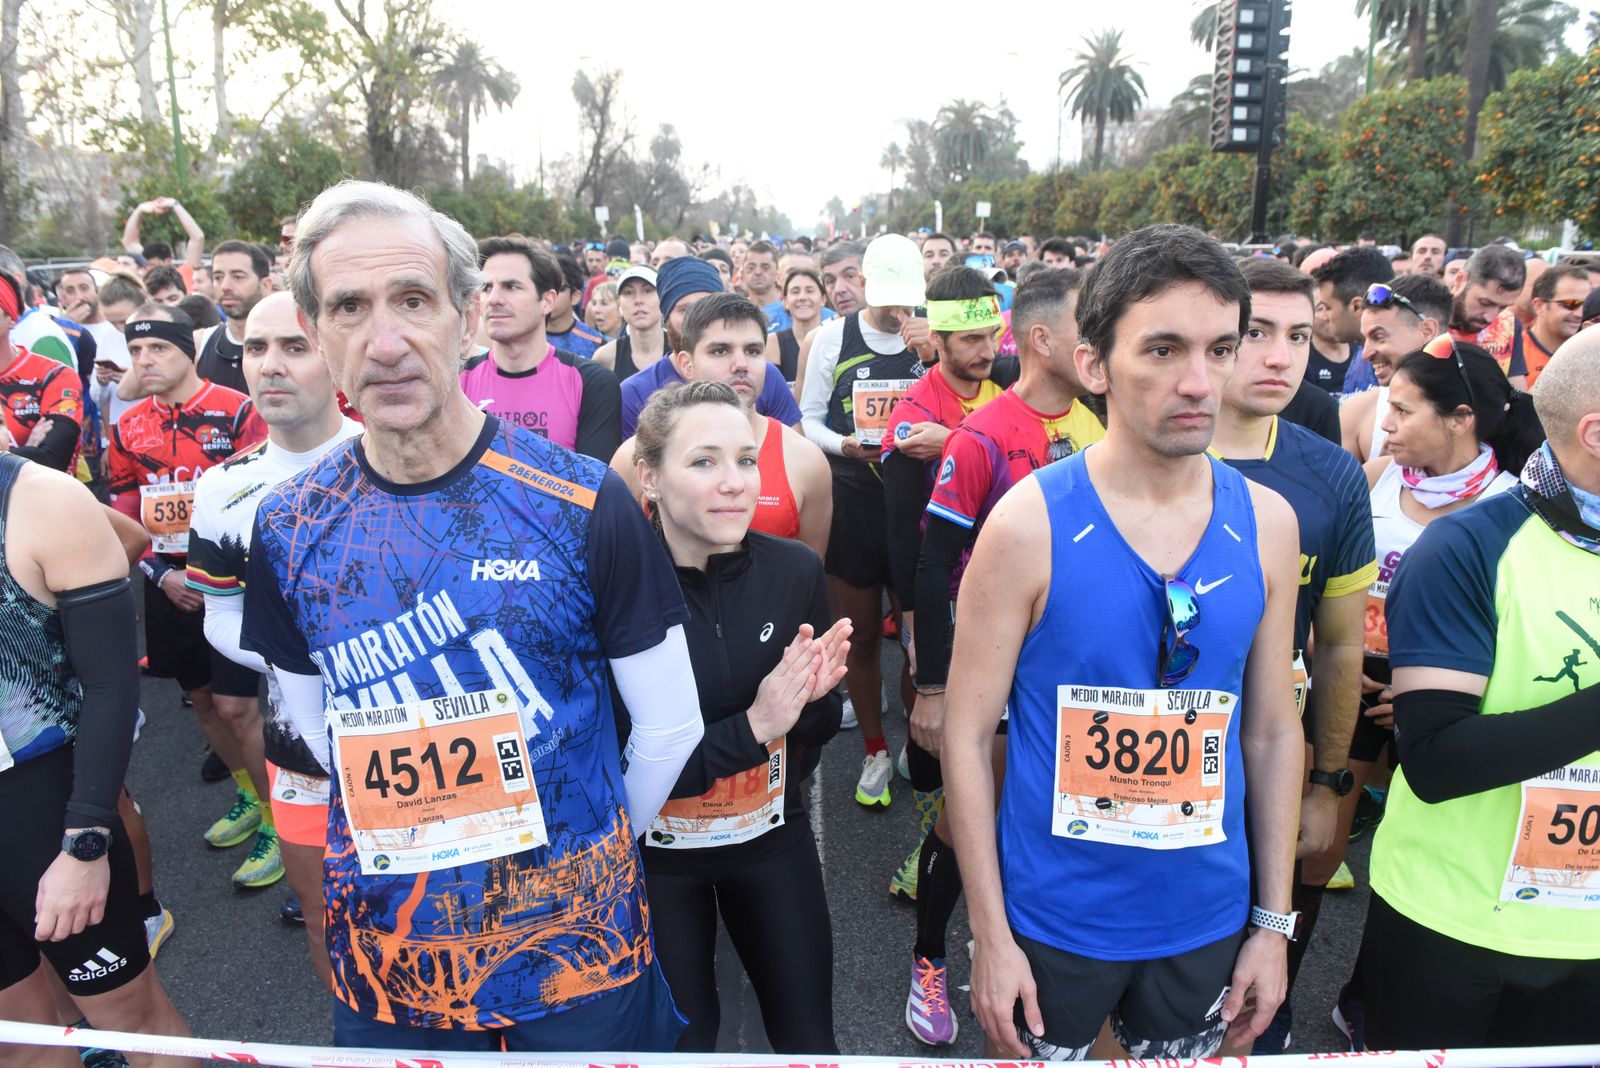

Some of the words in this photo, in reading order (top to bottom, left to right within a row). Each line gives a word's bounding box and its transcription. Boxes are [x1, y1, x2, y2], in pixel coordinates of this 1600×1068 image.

[134, 321, 151, 332] edp
[508, 463, 576, 498] 28ENERO24
[471, 559, 541, 581] HOKA
[328, 589, 468, 690] MARATÓN
[340, 711, 365, 729] MEDIO
[365, 706, 408, 726] MARATÓN
[433, 692, 491, 721] SEVILLA
[1071, 688, 1099, 703] MEDIO
[1102, 689, 1145, 708] MARATÓN
[1167, 690, 1212, 711] SEVILLA
[529, 727, 564, 763] DICIÓN
[1085, 724, 1191, 776] 3820
[365, 737, 484, 799] 4512
[1569, 768, 1600, 784] MARA
[345, 773, 355, 798] CAJÓN
[699, 766, 761, 801] 18
[1109, 775, 1139, 786] Musho
[1141, 778, 1172, 788] Tronqui
[396, 797, 423, 809] David
[424, 793, 457, 804] Lanzas
[1113, 793, 1146, 803] Troncoso
[417, 814, 444, 823] Lanzas
[1547, 803, 1600, 846] 50
[710, 833, 731, 841] HOKA
[1132, 830, 1159, 841] HOKA
[1523, 820, 1533, 841] CAJÓN
[432, 848, 460, 861] HOKA
[68, 957, 128, 983] adidas
[1205, 1011, 1220, 1022] NIK
